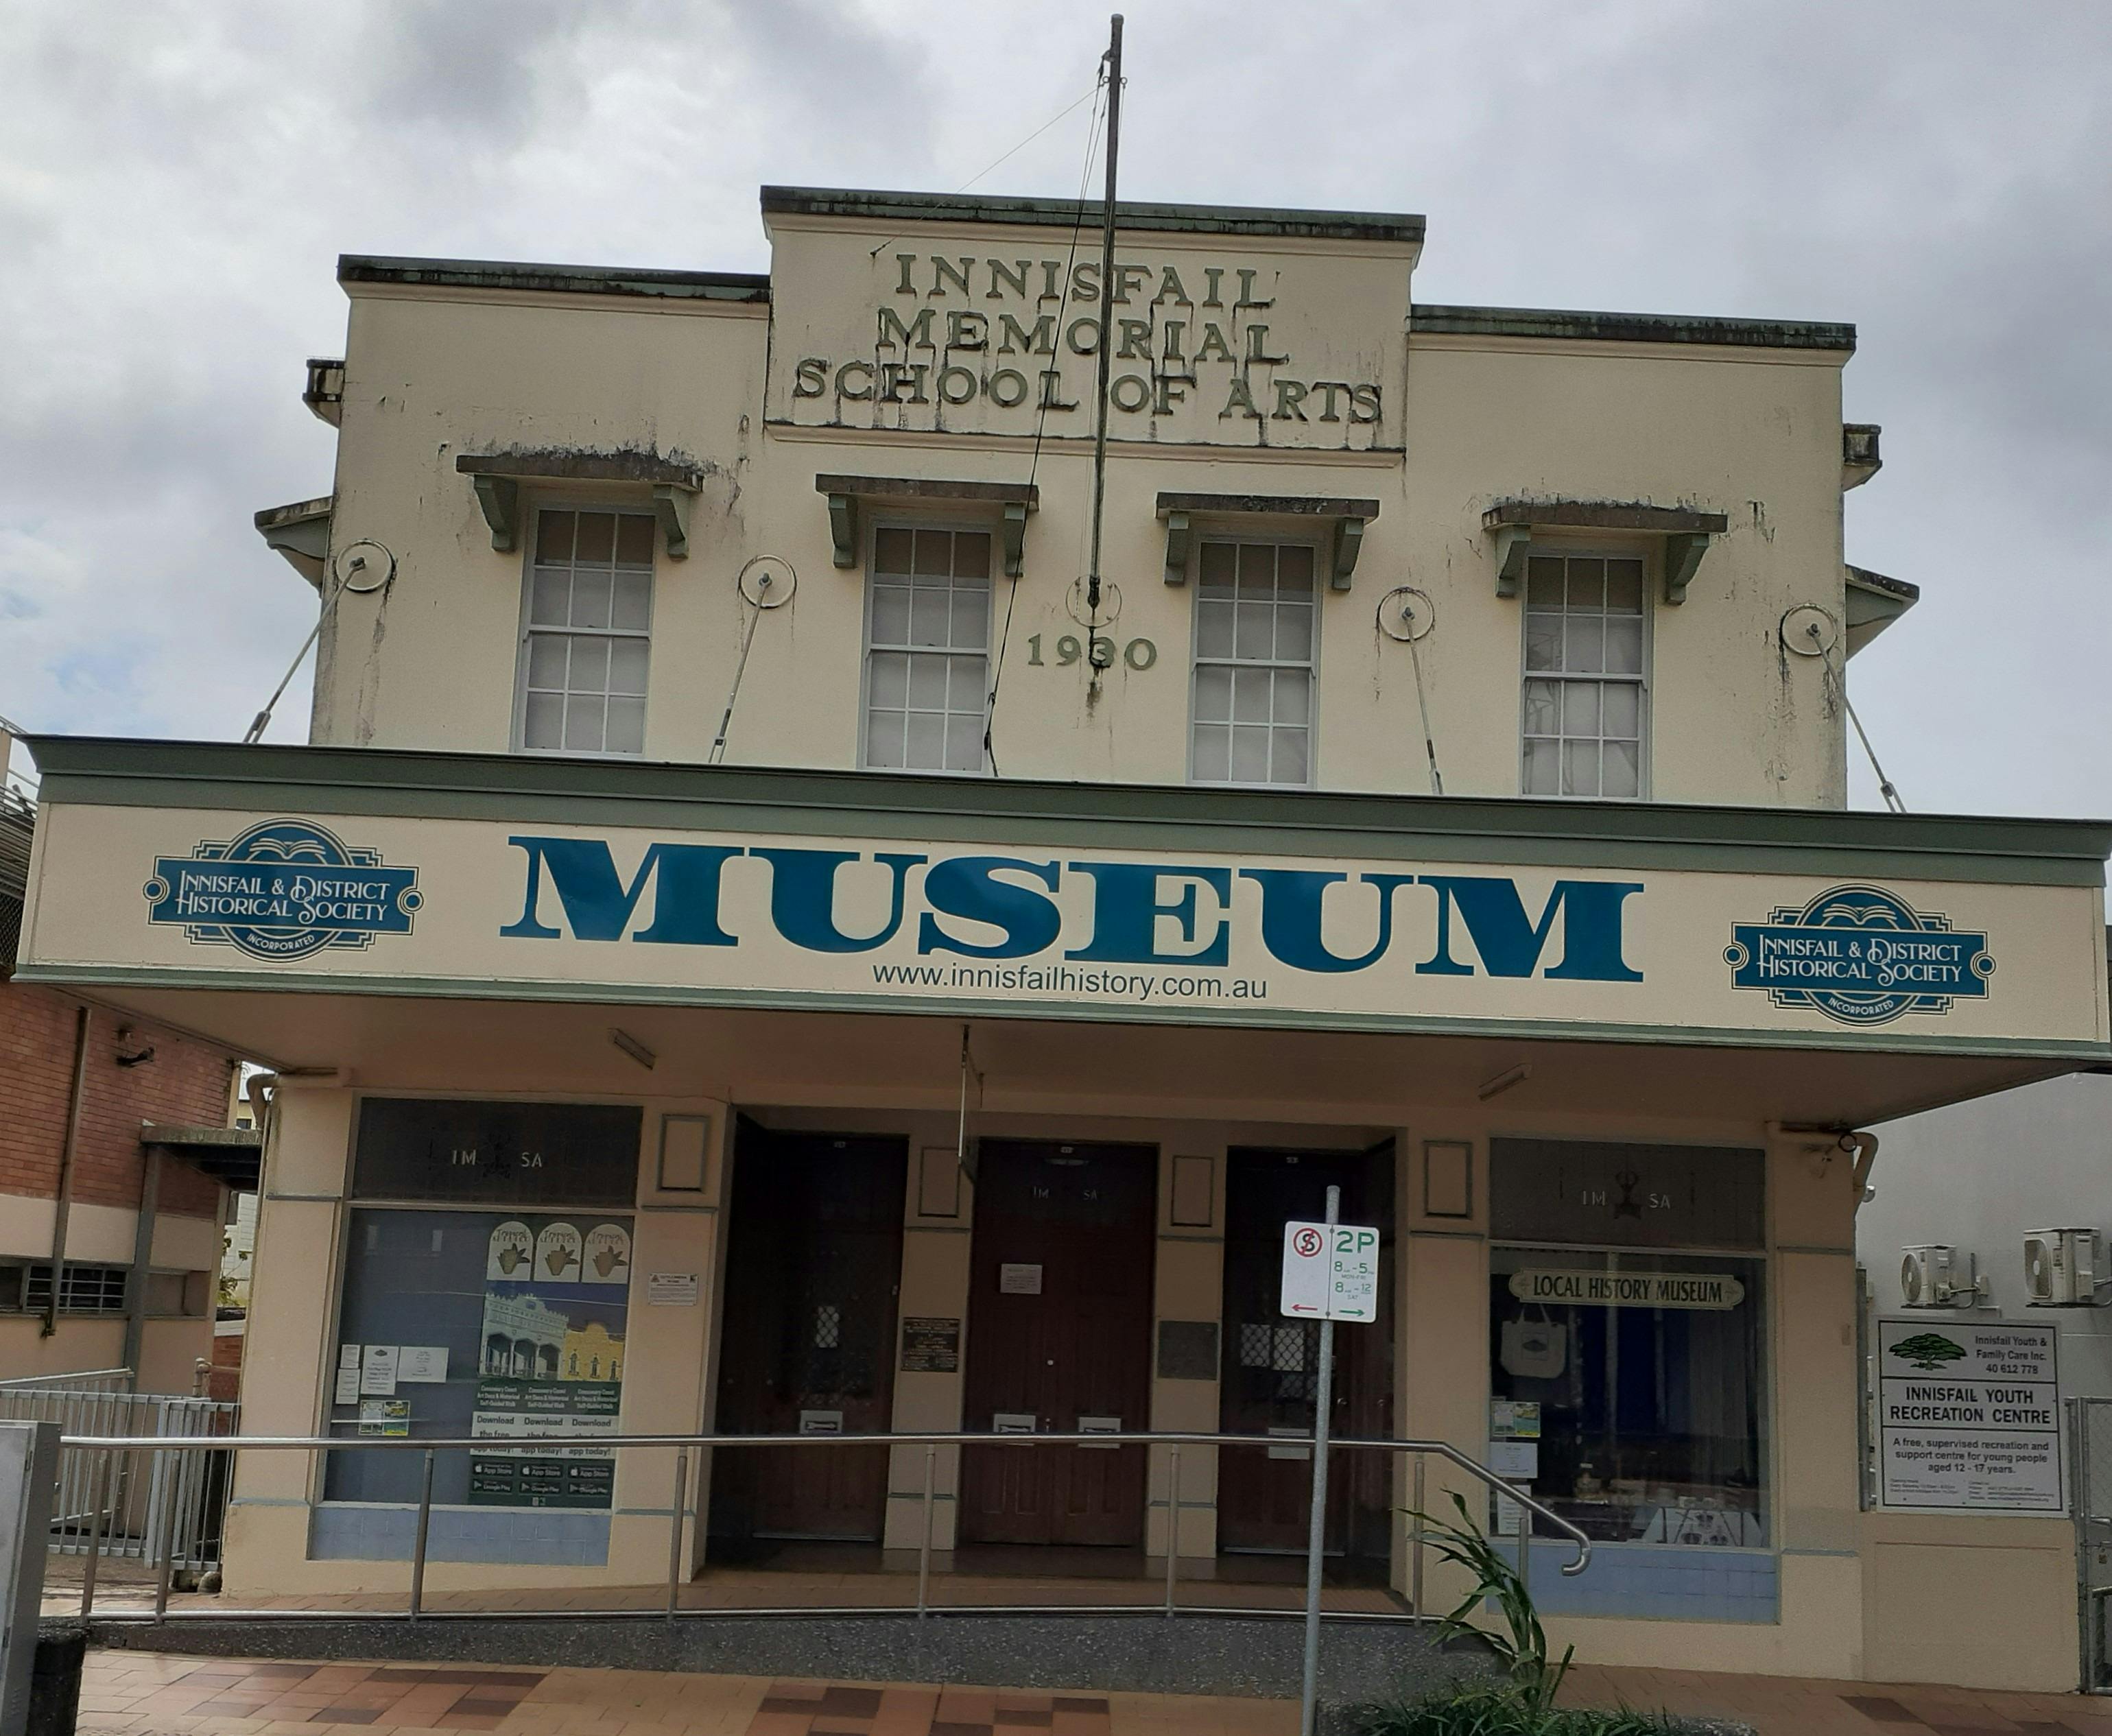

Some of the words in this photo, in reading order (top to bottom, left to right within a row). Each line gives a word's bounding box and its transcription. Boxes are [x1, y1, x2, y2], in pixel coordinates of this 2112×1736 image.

[895, 253, 1276, 309] INNISFAIL
[877, 307, 1290, 366] MEMORIAL
[793, 358, 1080, 412] SCHOOL
[1111, 374, 1196, 416] OF
[1219, 378, 1381, 424] ARTS
[1028, 634, 1158, 671] 1930
[180, 870, 266, 895] INNISFAIL
[272, 879, 285, 896] &
[290, 875, 390, 904] DISTRICT
[176, 891, 293, 917] HISTORICAL
[298, 896, 388, 925] SOCIETY
[499, 835, 1646, 984] MUSEUM
[246, 933, 315, 951] INCORPORATED
[1759, 934, 1844, 958] INNISFAIL
[1849, 942, 1861, 958] &
[1868, 938, 1962, 965] DISTRICT
[1757, 954, 1872, 980] HISTORICAL
[1877, 959, 1962, 987] SOCIETY
[873, 962, 1268, 1000] www.innisfailhistory.com.au
[1827, 997, 1894, 1015] INCORPORATED
[521, 1152, 543, 1168] SA
[1649, 1193, 1671, 1209] SA
[1336, 1230, 1375, 1254] 2P
[1534, 1275, 1583, 1298] LOCAL
[1588, 1278, 1651, 1300] HISTORY
[1656, 1280, 1722, 1303] MUSEUM
[1975, 1335, 2010, 1345] Innisfail
[2013, 1337, 2037, 1346] Youth
[1976, 1350, 2006, 1361] Family
[2008, 1351, 2028, 1359] Care
[2031, 1352, 2047, 1360] Inc.
[1986, 1364, 1997, 1372] 40
[2000, 1365, 2018, 1373] 612
[2021, 1365, 2038, 1374] 778
[1906, 1386, 1978, 1402] INNISFAIL
[1986, 1389, 2033, 1404] YOUTH
[477, 1416, 514, 1425] Download
[524, 1417, 563, 1426] Download
[572, 1418, 611, 1427] Download
[1890, 1405, 1983, 1422] RECREATION
[1993, 1409, 2050, 1424] CENTRE
[538, 1447, 562, 1455] today!
[585, 1447, 610, 1456] today!
[1893, 1438, 1901, 1446] A
[1903, 1438, 1924, 1448] free,
[1926, 1440, 1978, 1450] supervised
[1981, 1441, 2028, 1450] recreation
[2031, 1442, 2049, 1451] and
[1895, 1450, 1932, 1460] support
[1935, 1451, 1965, 1460] centre
[1967, 1452, 1981, 1461] for
[1983, 1453, 2013, 1464] young
[2015, 1453, 2048, 1464] people
[1928, 1463, 1951, 1473] aged
[1954, 1464, 1965, 1472] 12
[1974, 1464, 1985, 1473] 17
[1987, 1465, 2016, 1475] years.
